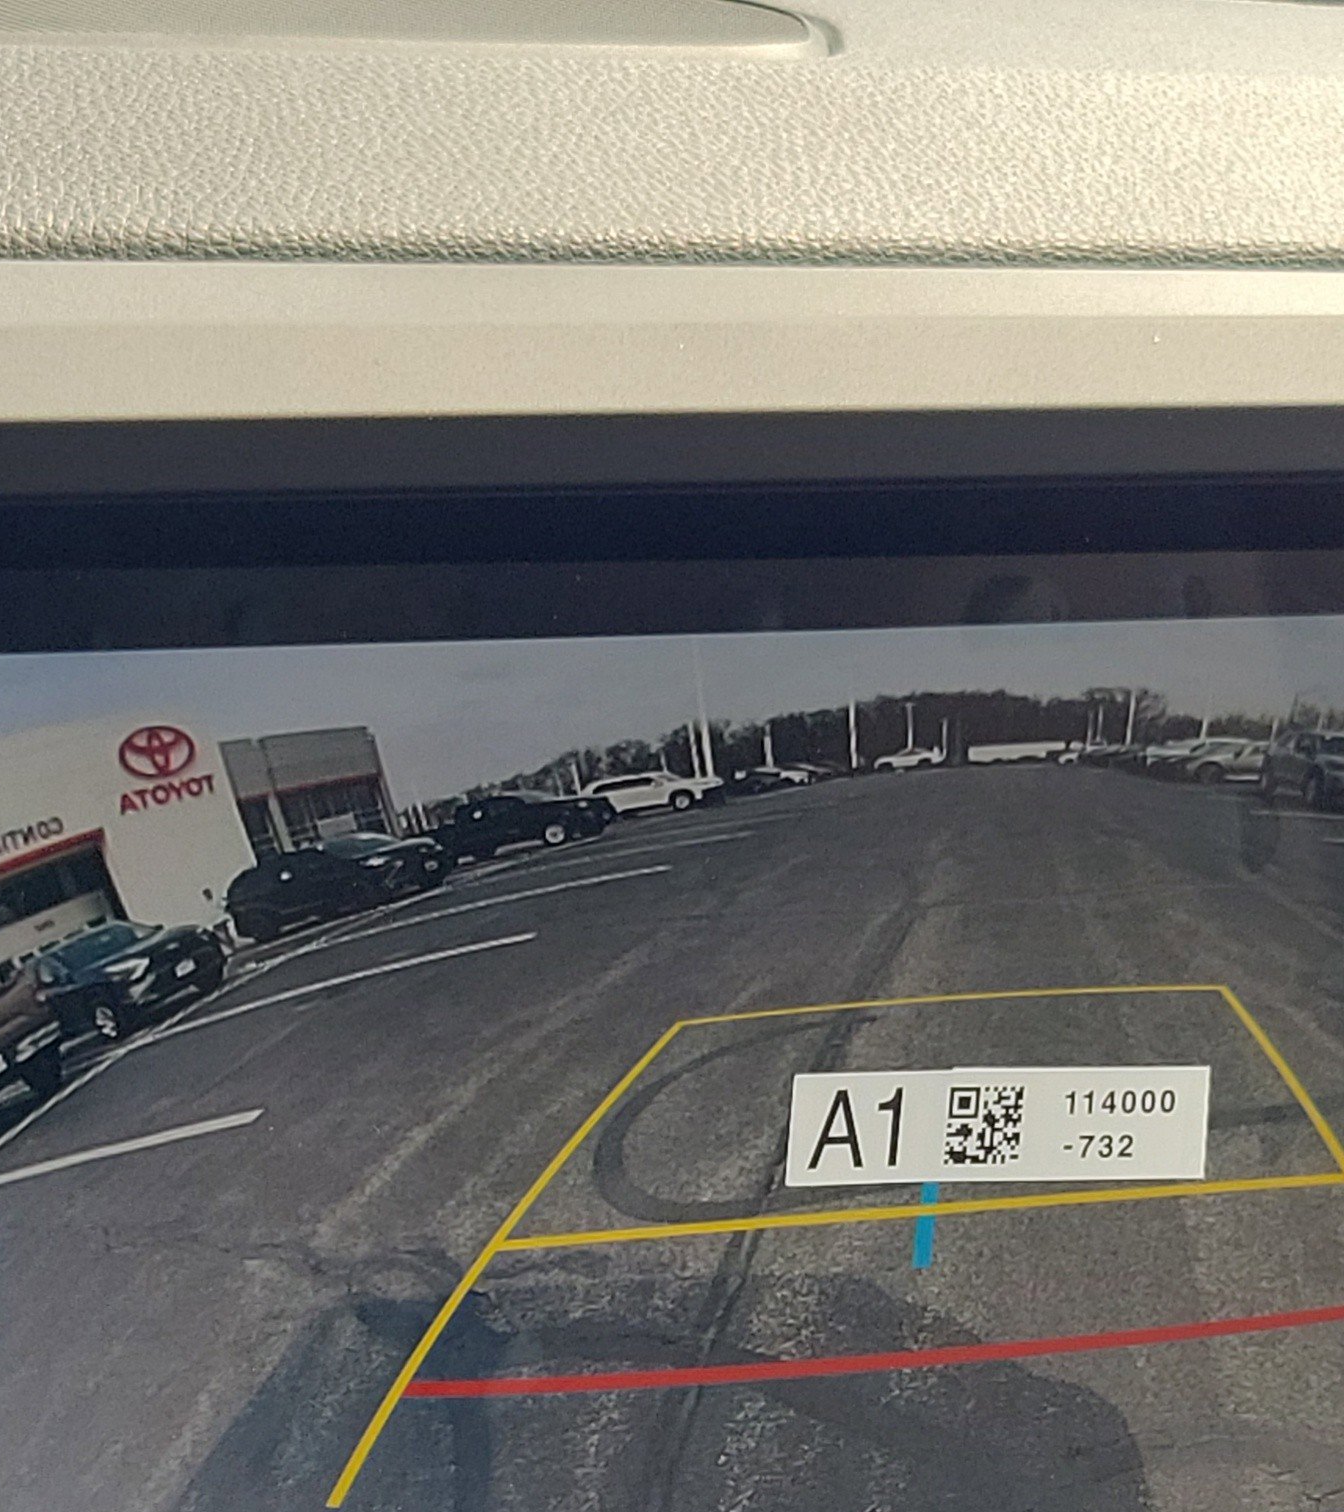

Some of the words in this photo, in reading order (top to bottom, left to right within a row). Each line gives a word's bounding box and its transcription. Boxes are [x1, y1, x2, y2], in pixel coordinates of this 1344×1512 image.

[1064, 1089, 1177, 1116] 114000
[808, 1087, 904, 1170] A1
[1063, 1134, 1134, 1160] -732
